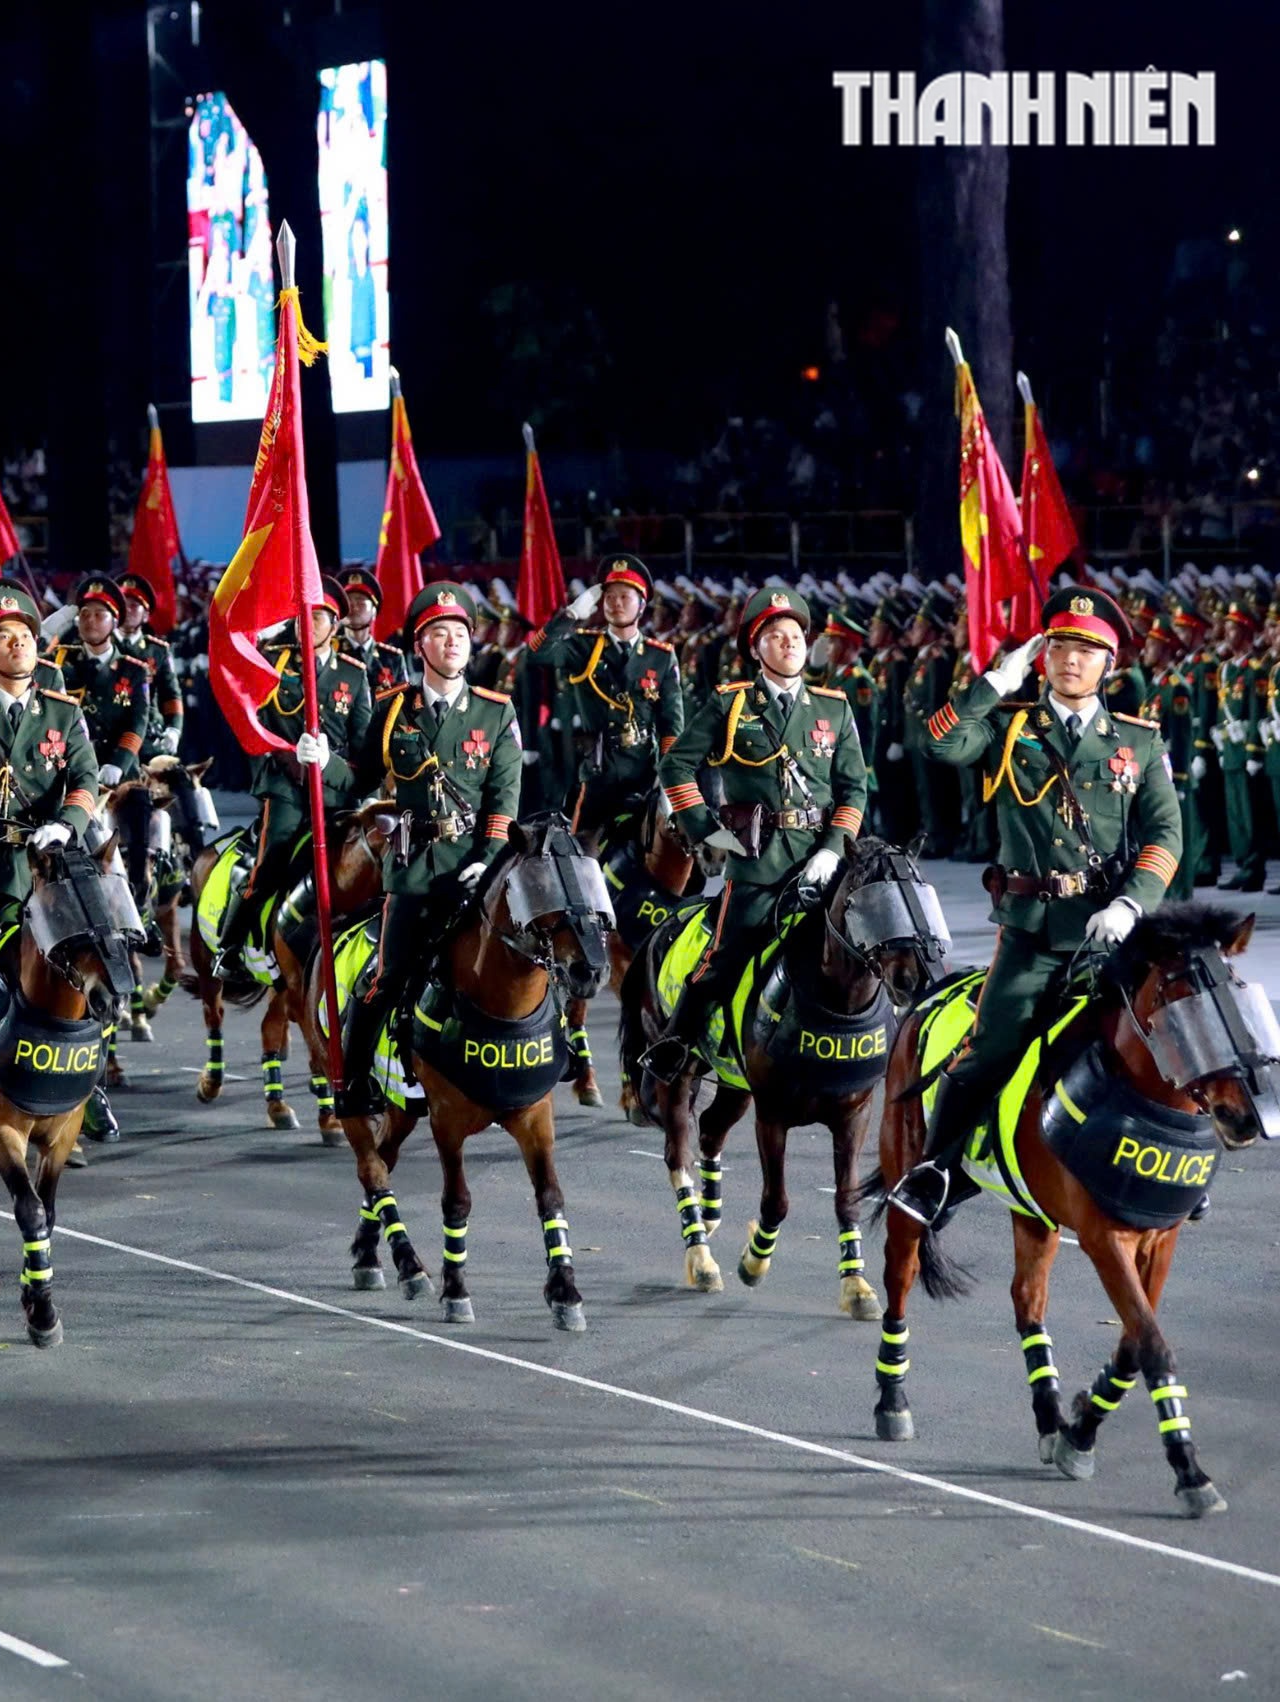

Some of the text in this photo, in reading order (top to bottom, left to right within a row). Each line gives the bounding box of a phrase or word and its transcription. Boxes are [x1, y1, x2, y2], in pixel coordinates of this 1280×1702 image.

[14, 1039, 100, 1072] POLICE
[464, 1035, 554, 1068] POLICE
[799, 1027, 887, 1060] POLICE
[1112, 1136, 1216, 1185] POLICE
